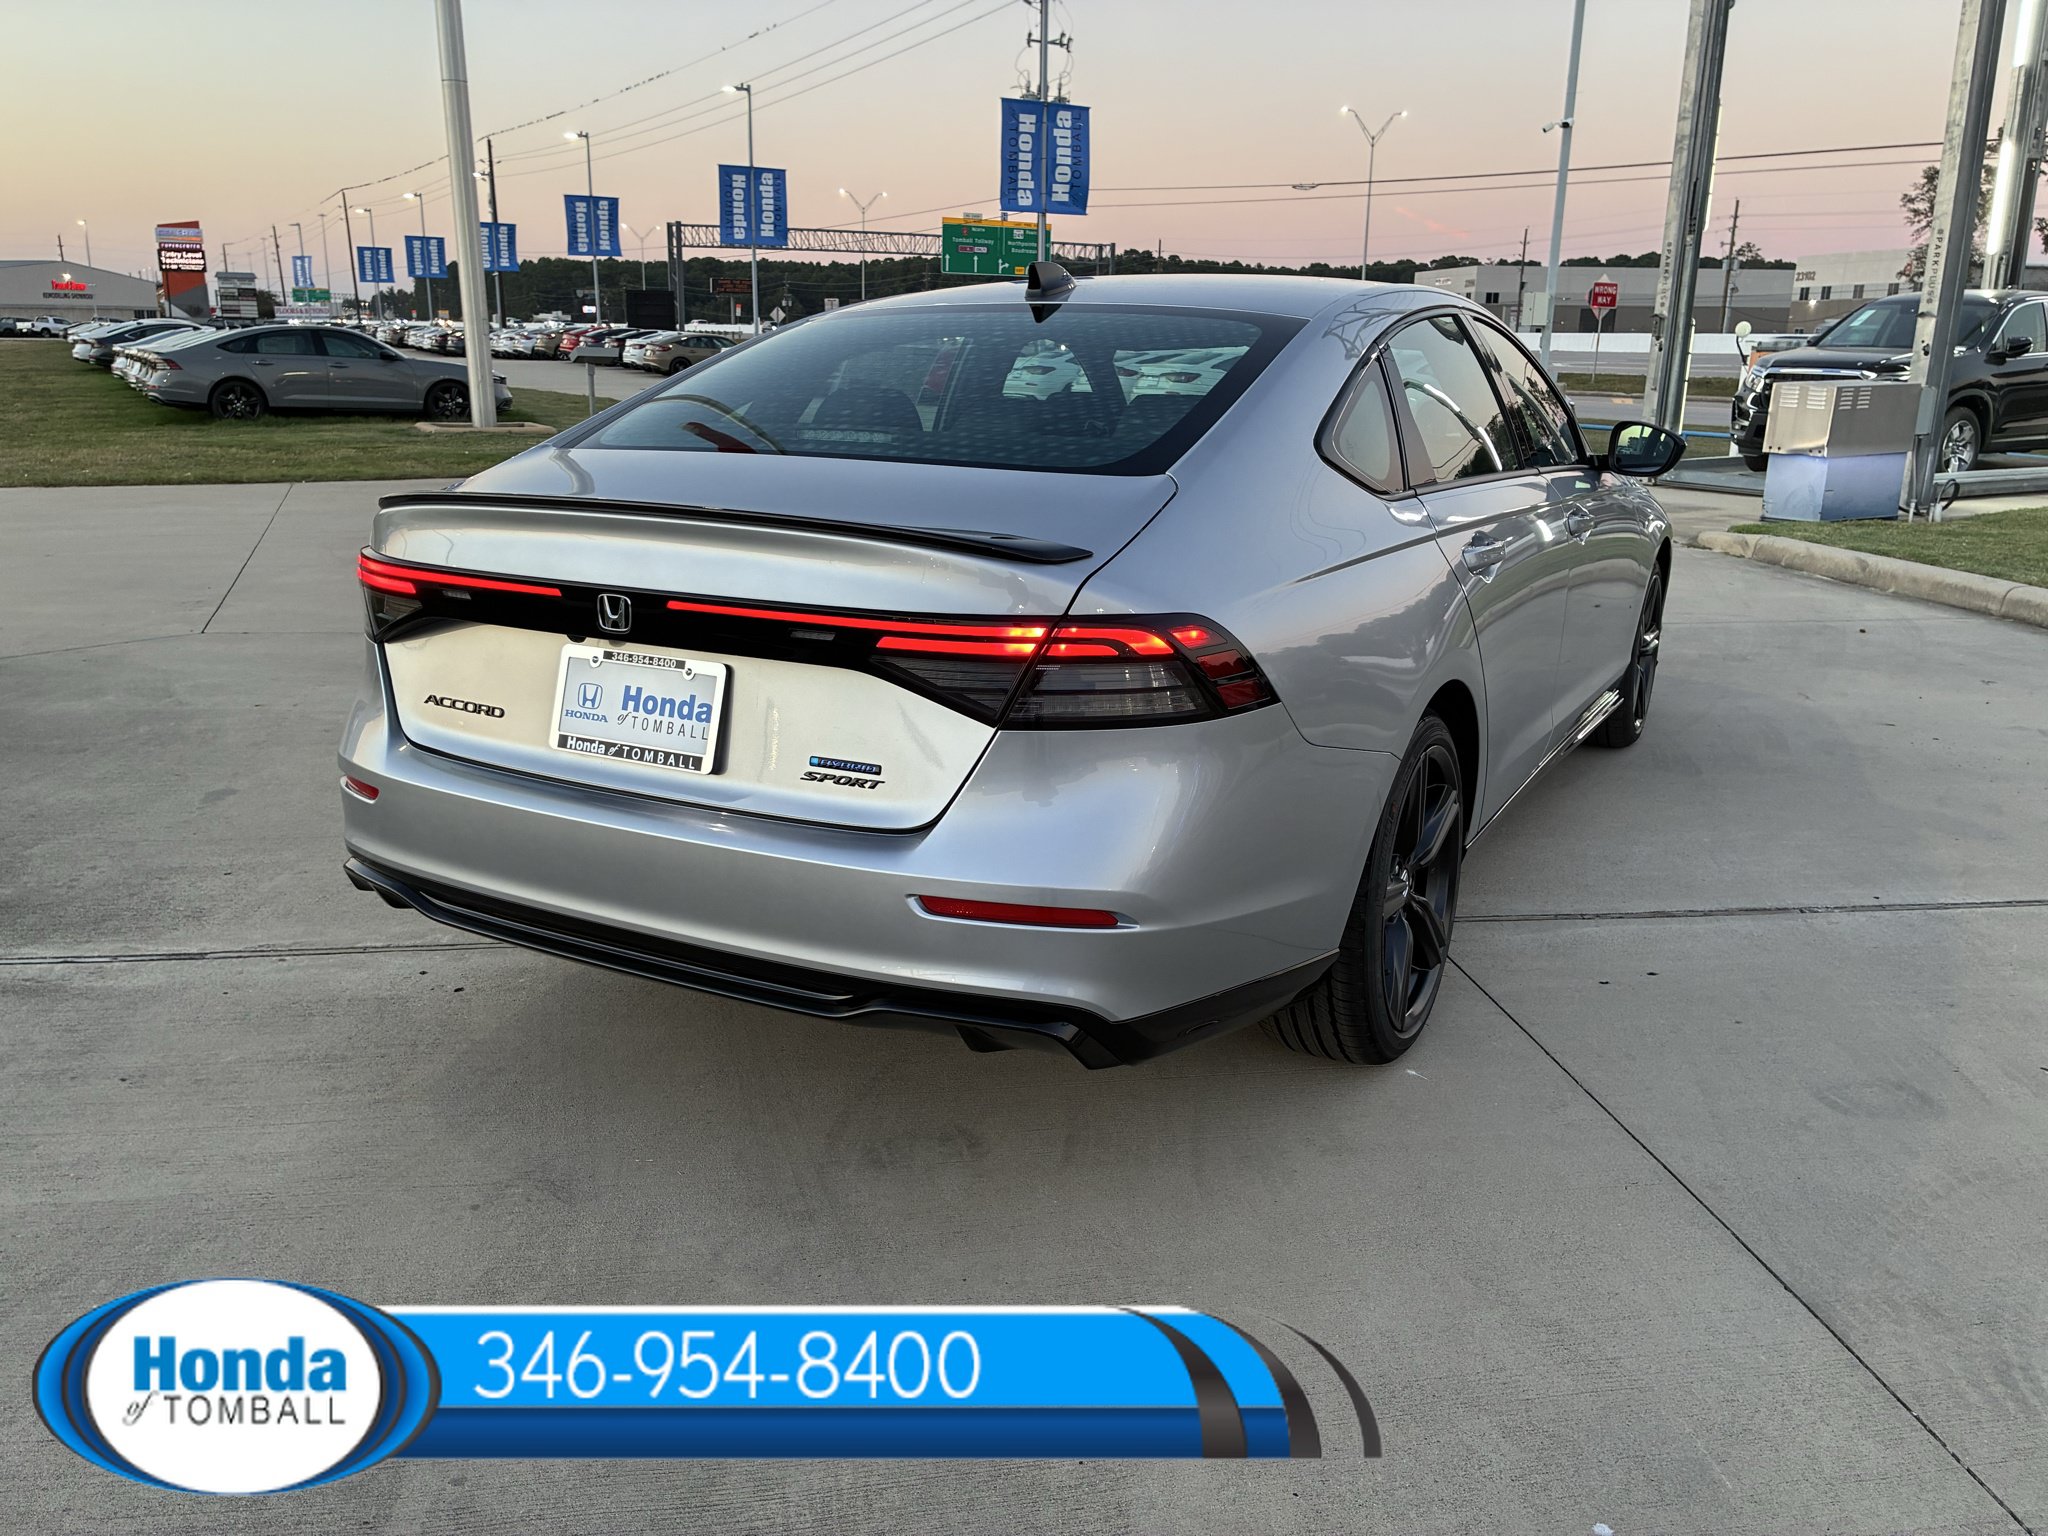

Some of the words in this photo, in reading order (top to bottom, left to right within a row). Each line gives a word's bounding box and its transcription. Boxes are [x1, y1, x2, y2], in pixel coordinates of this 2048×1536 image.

[1016, 113, 1037, 206] Honda
[1051, 110, 1072, 202] Honda
[731, 173, 747, 240] Honda
[758, 171, 775, 237] Honda
[574, 201, 589, 253] Honda
[596, 200, 612, 251] Honda
[1594, 285, 1618, 296] WRONG
[1597, 296, 1612, 305] WAY
[423, 694, 506, 719] ACCORD
[565, 709, 609, 723] HONDA
[621, 684, 713, 724] Honda
[617, 711, 631, 726] of
[631, 715, 709, 741] TOMBALL
[566, 736, 606, 755] Honda
[607, 743, 621, 756] of
[622, 746, 695, 770] TOMBALL
[799, 771, 886, 790] SPORT
